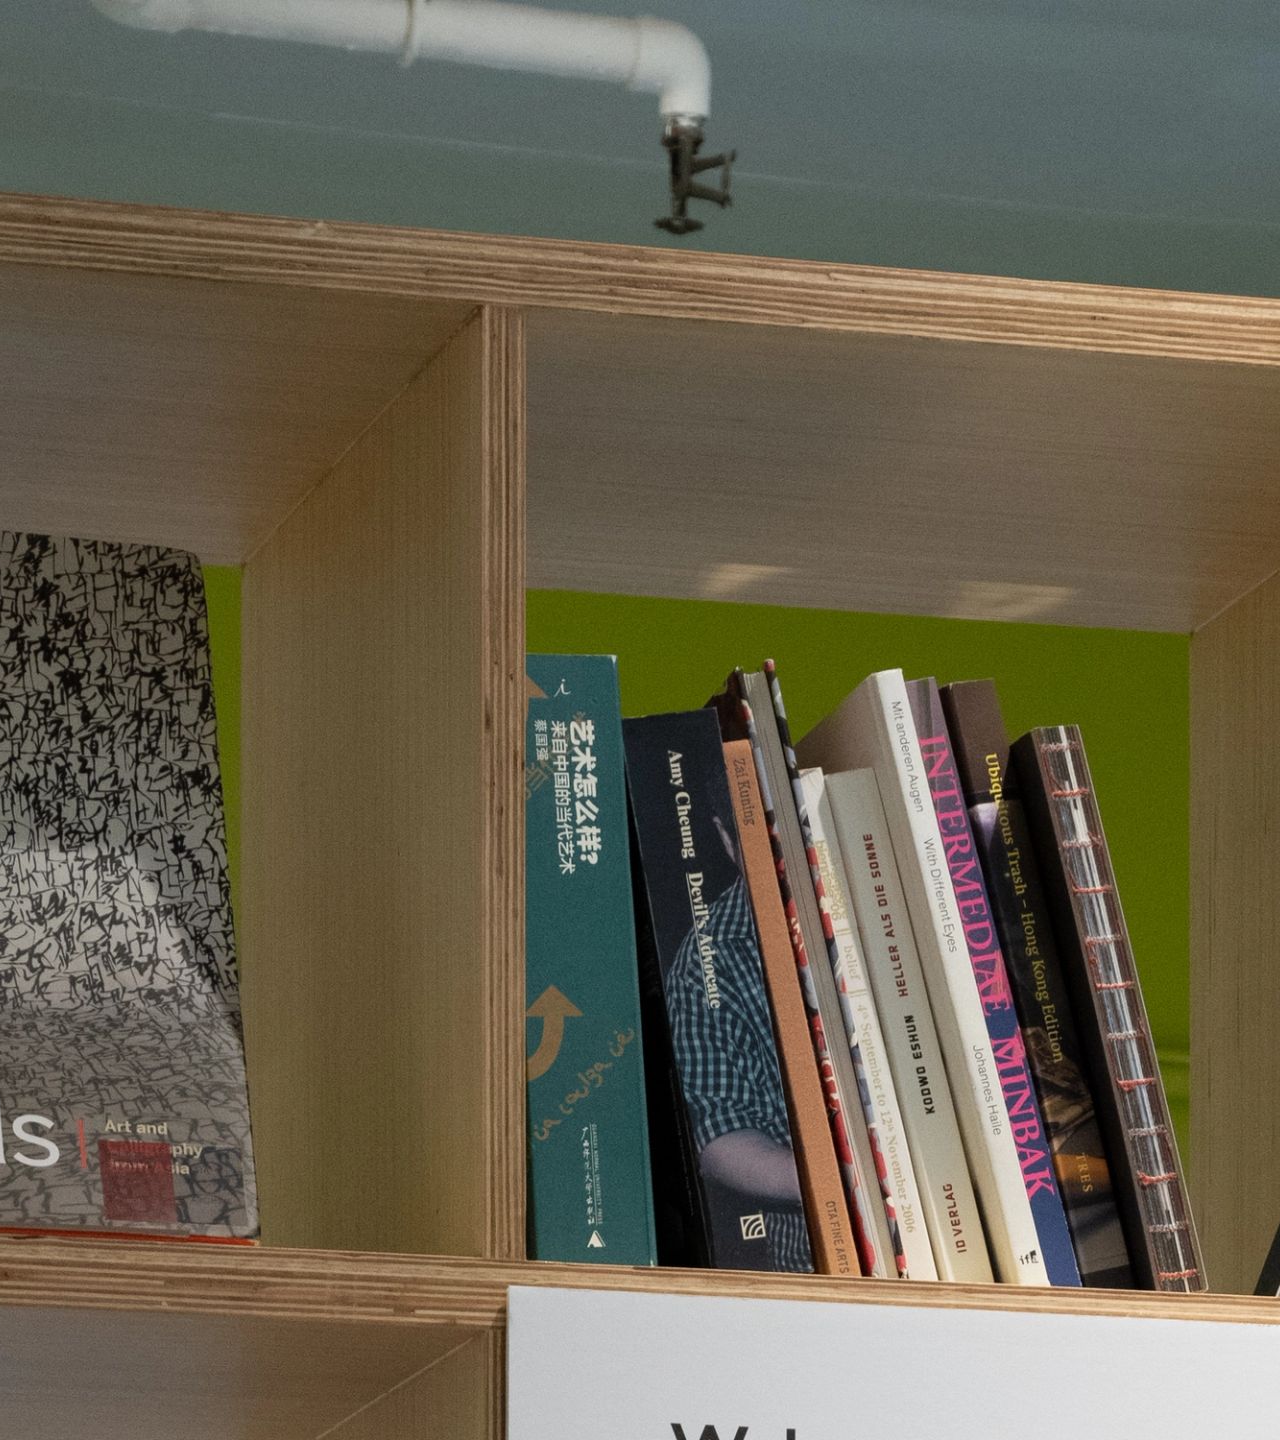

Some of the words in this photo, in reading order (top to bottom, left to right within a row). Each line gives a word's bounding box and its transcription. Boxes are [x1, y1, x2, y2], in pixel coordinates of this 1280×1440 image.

[892, 701, 903, 720] Mit
[533, 714, 550, 766] 蔡国强
[668, 750, 683, 786] Amy
[895, 723, 913, 771] anderen
[551, 716, 575, 874] 来自中国的当代艺术
[568, 716, 603, 864] 艺术怎么样?
[908, 774, 923, 812] Augen
[675, 792, 694, 858] Cheung
[687, 871, 714, 933] Devil’s
[985, 753, 1013, 844] Ubiquitous
[1008, 851, 1026, 895] Trash
[1021, 913, 1038, 955] Hong
[1032, 960, 1048, 1000] Kong
[1042, 1005, 1062, 1062] Edition
[697, 934, 722, 1010] Advocate
[921, 735, 1011, 1016] INTERMEDIAE
[991, 1024, 1056, 1200] MINBAK
[905, 1016, 922, 1059] ESHUN
[916, 1066, 934, 1114] KODWO
